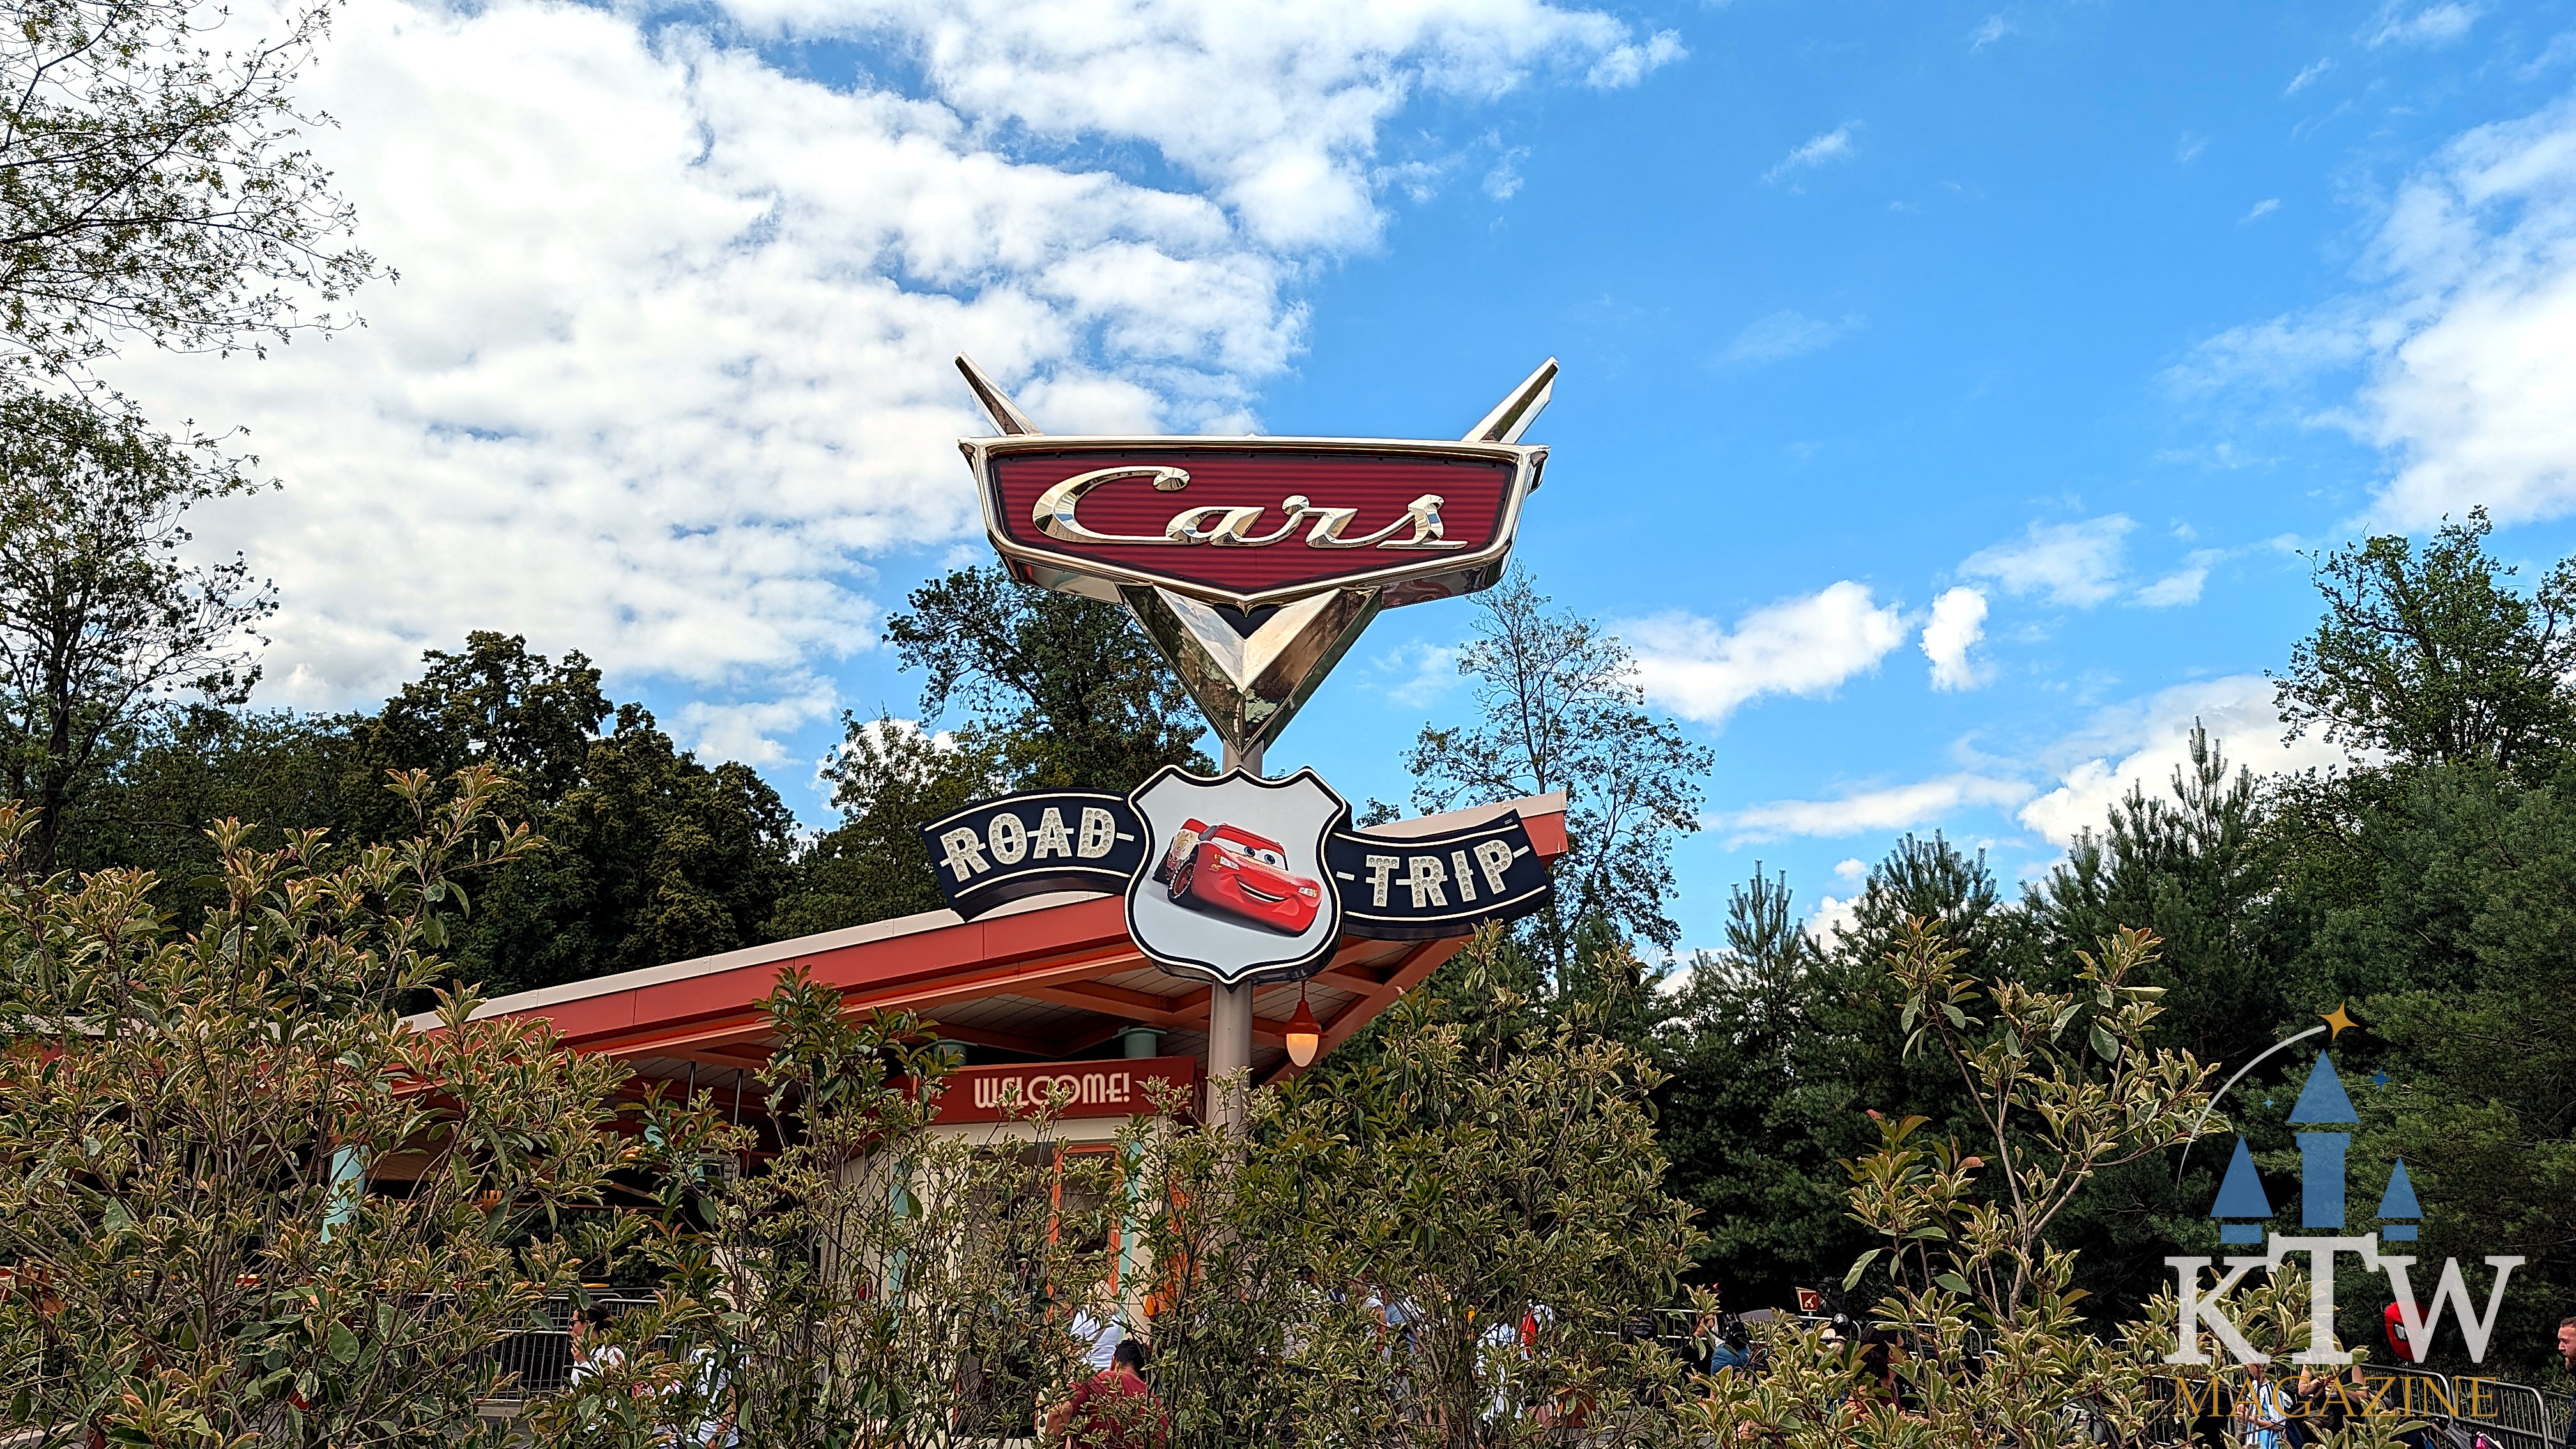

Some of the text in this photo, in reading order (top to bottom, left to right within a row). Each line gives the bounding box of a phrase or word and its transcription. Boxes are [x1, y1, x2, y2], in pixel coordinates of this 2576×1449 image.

[1032, 466, 1468, 548] Cars
[940, 807, 1513, 908] ROAD TRIP
[974, 1072, 1130, 1108] WELCOME!
